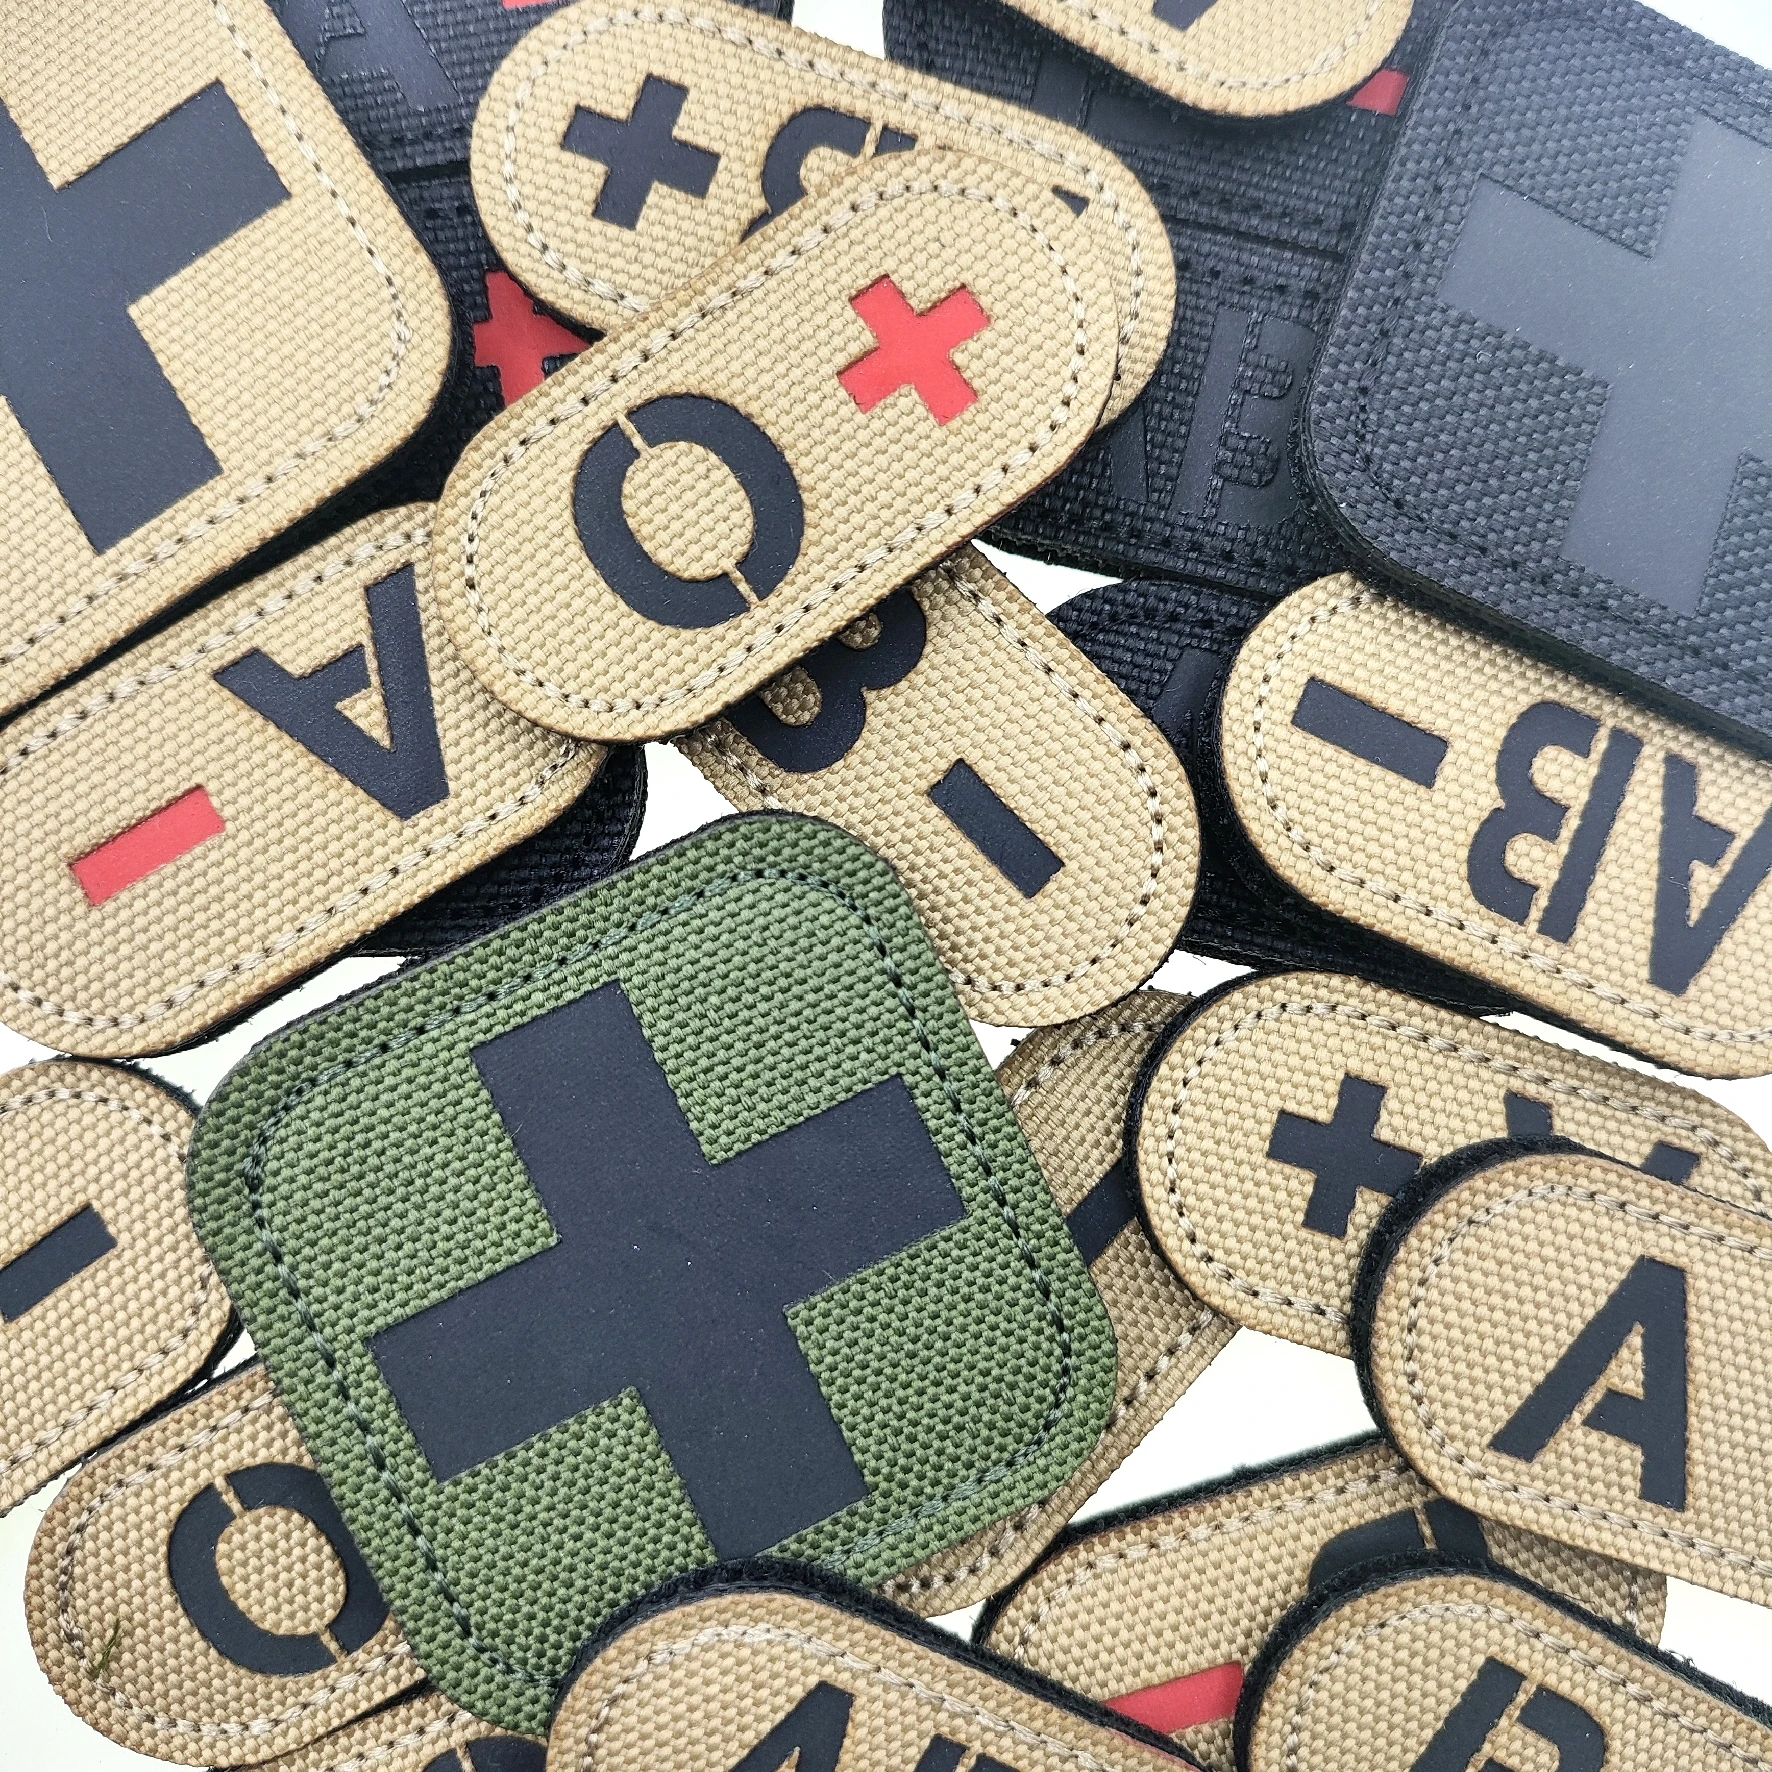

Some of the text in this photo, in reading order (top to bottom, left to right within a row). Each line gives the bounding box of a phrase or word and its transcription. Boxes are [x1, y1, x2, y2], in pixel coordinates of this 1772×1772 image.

[573, 393, 805, 629] O
[213, 562, 450, 821] A
[1489, 1256, 1690, 1512] A
